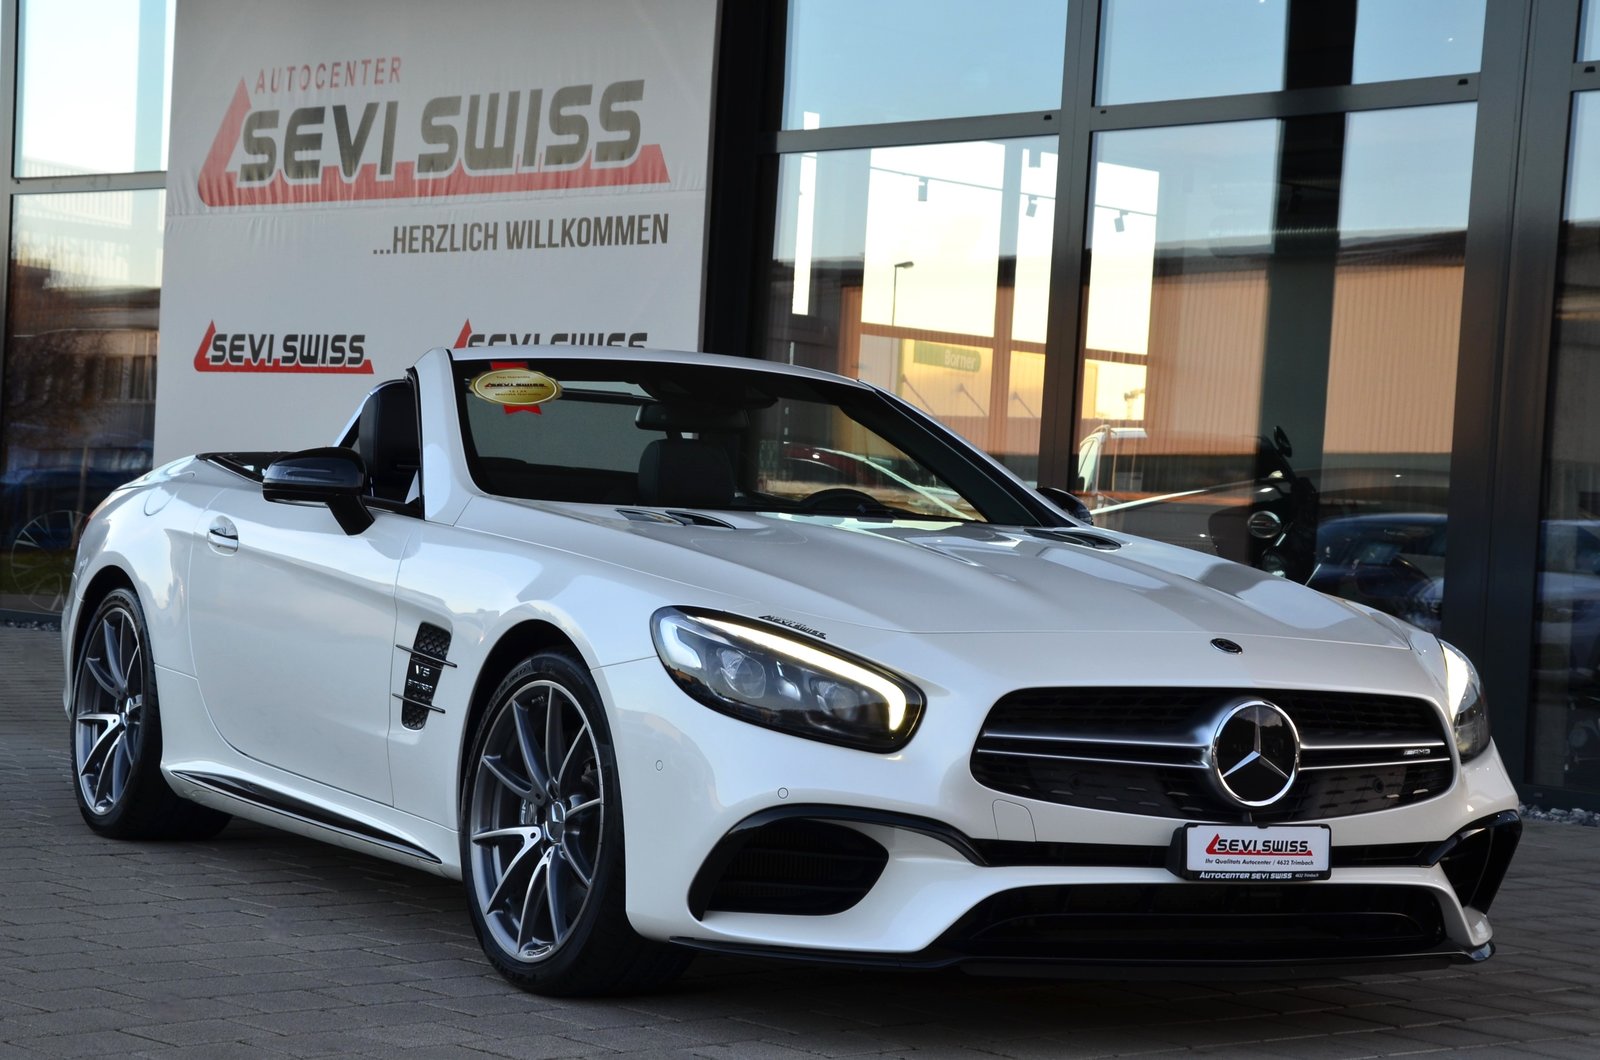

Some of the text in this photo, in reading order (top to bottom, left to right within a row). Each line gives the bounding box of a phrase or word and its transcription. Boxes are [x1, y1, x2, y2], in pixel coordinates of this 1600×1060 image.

[254, 56, 402, 94] AUTOCENTER
[240, 79, 645, 184] SEVI SWISS
[373, 213, 669, 255] ...HERZLICH WILLKOMMEN
[212, 334, 365, 365] SEVI SWISS
[1217, 839, 1308, 853] SEVI SWISS
